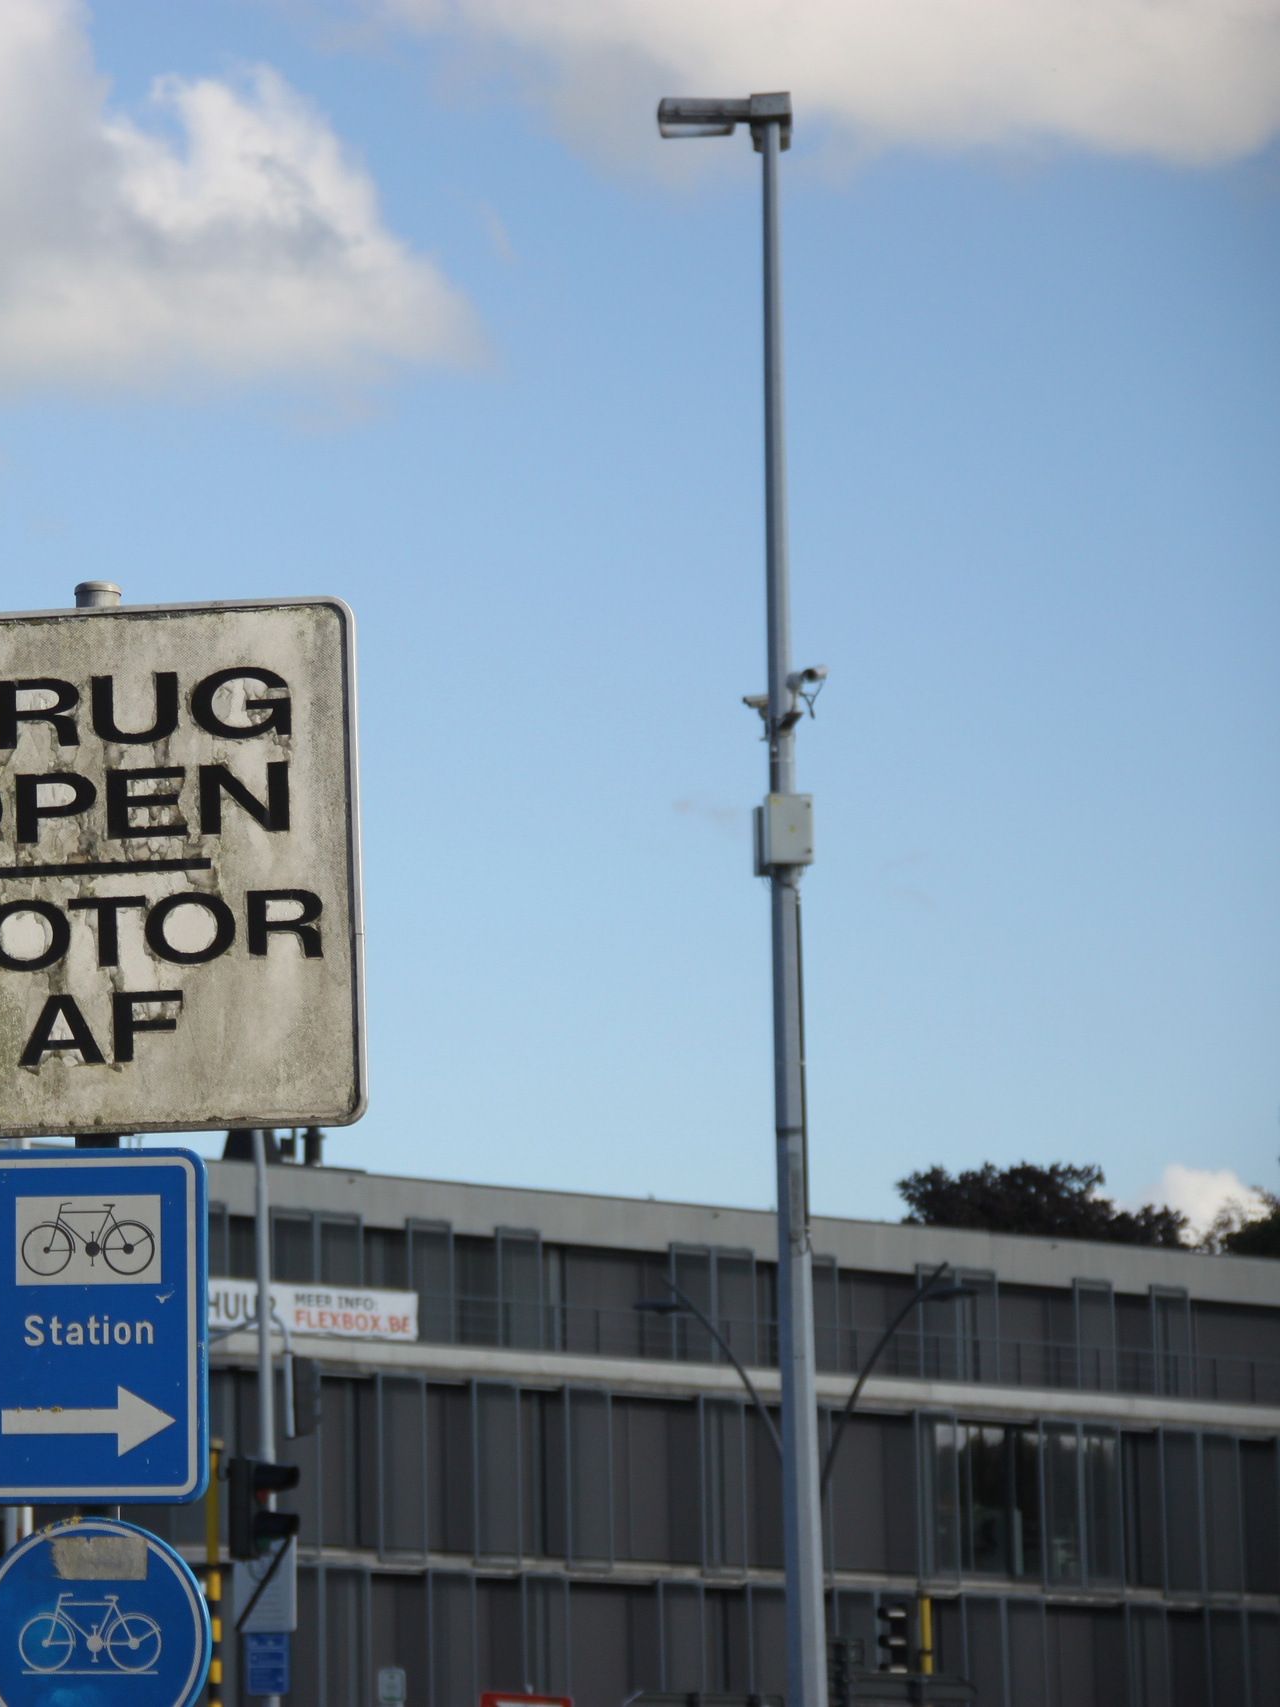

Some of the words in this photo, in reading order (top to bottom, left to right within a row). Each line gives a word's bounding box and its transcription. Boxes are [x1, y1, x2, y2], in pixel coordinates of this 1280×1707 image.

[18, 990, 183, 1067] AF
[294, 1293, 331, 1309] MEER
[24, 1314, 154, 1347] Station
[294, 1310, 411, 1333] FLEXBOX.BE
